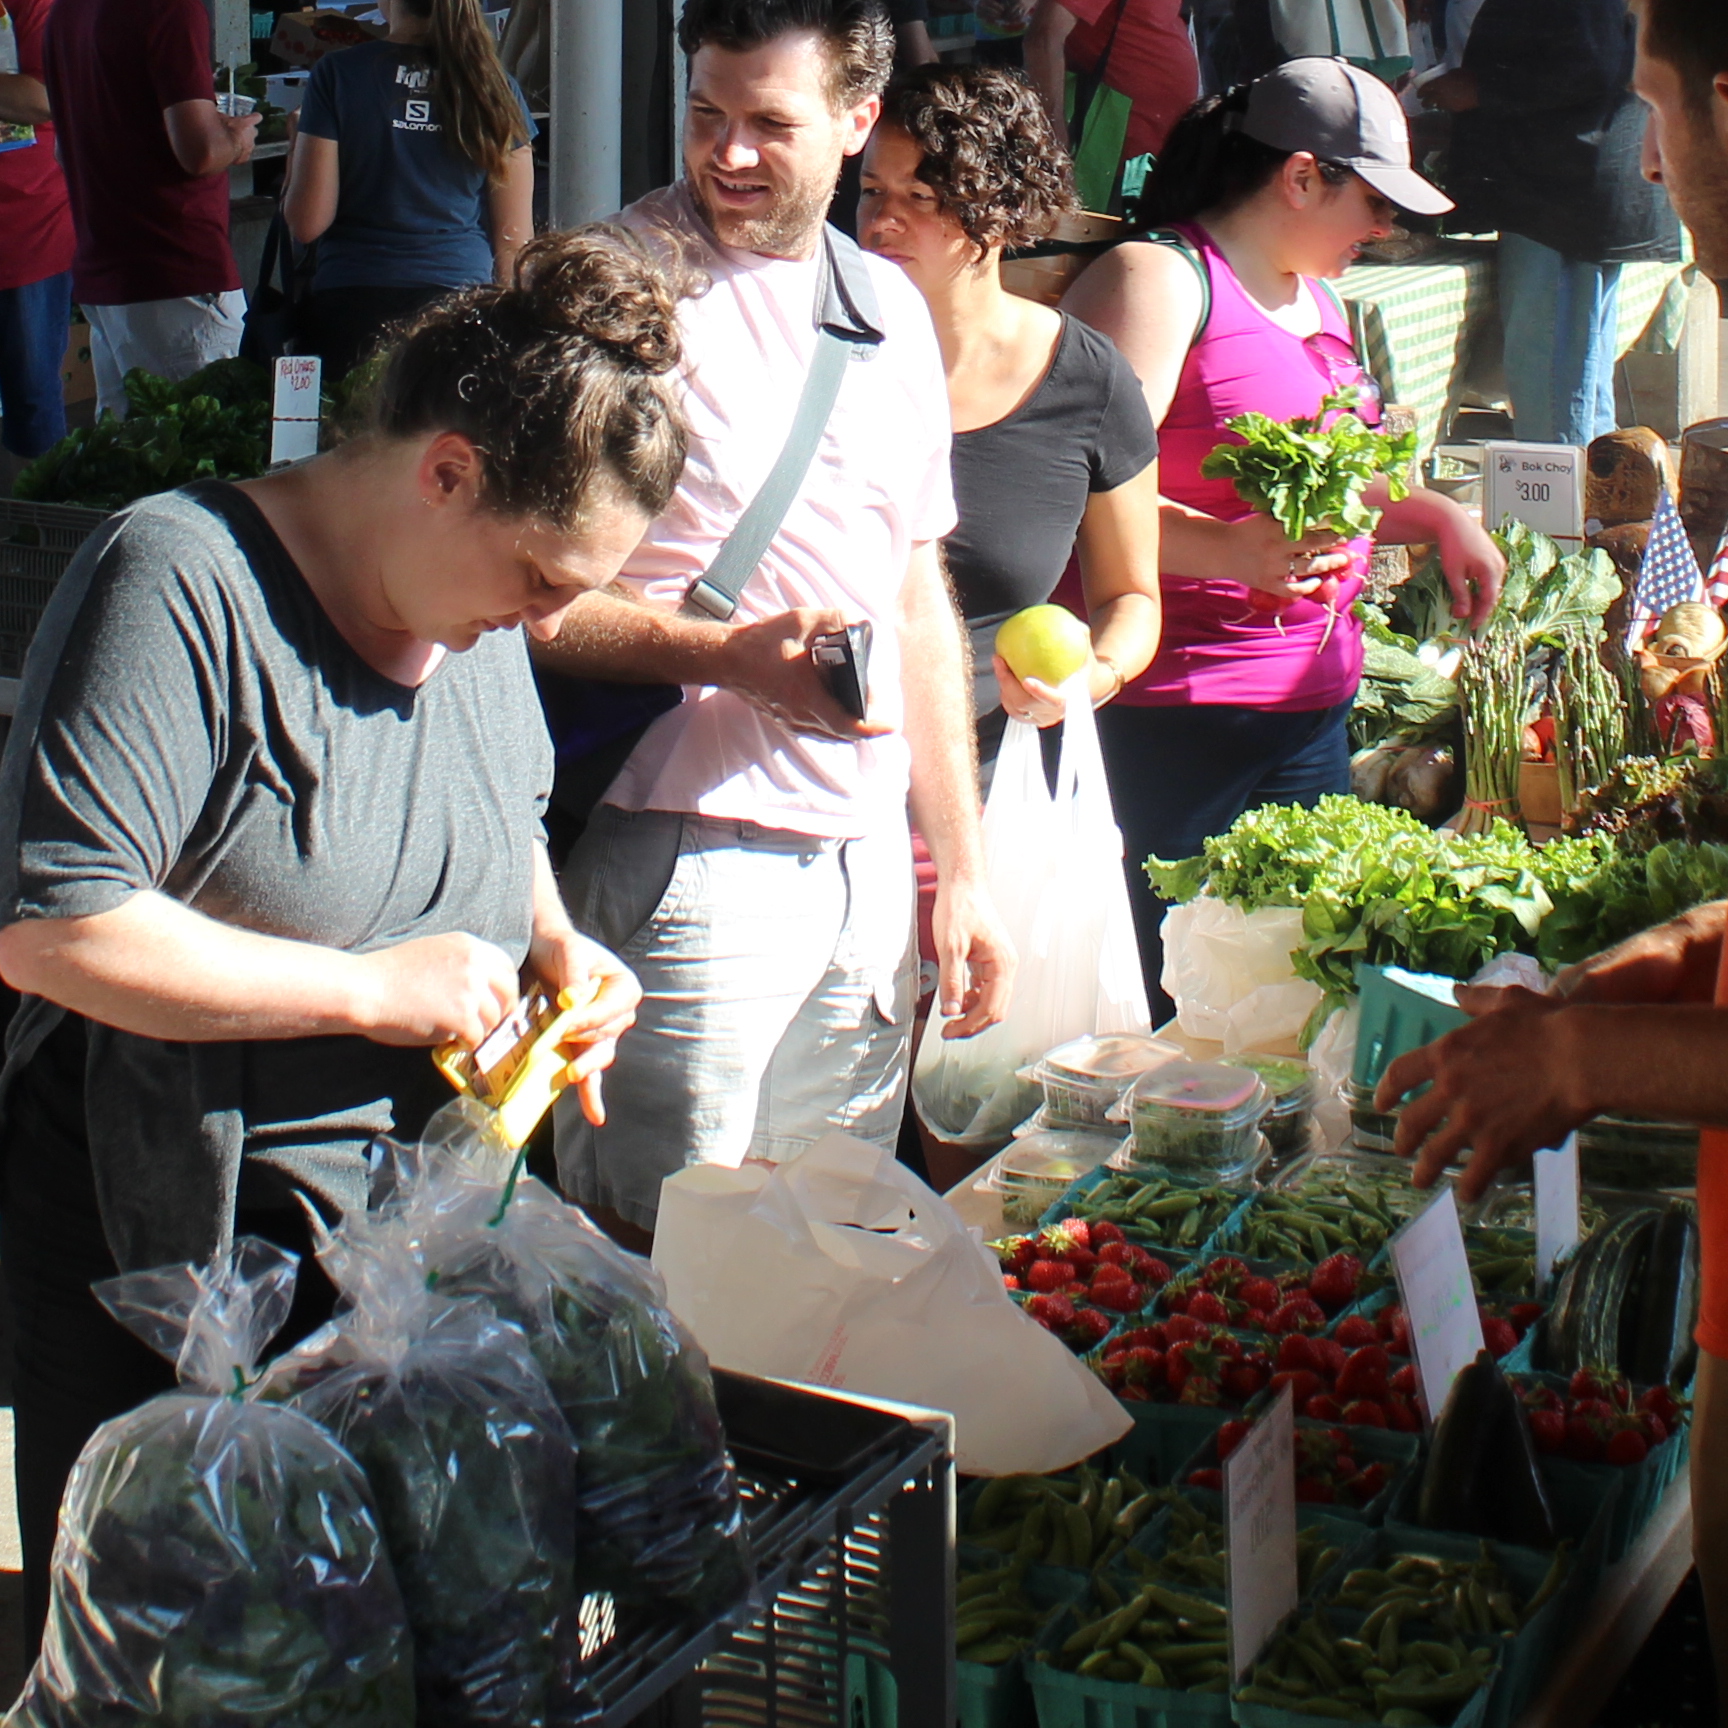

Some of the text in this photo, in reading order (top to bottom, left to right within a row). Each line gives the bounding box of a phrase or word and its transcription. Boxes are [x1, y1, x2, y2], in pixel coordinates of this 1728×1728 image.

[1522, 462, 1572, 474] Bok Choy
[1515, 479, 1550, 502] $3.00
